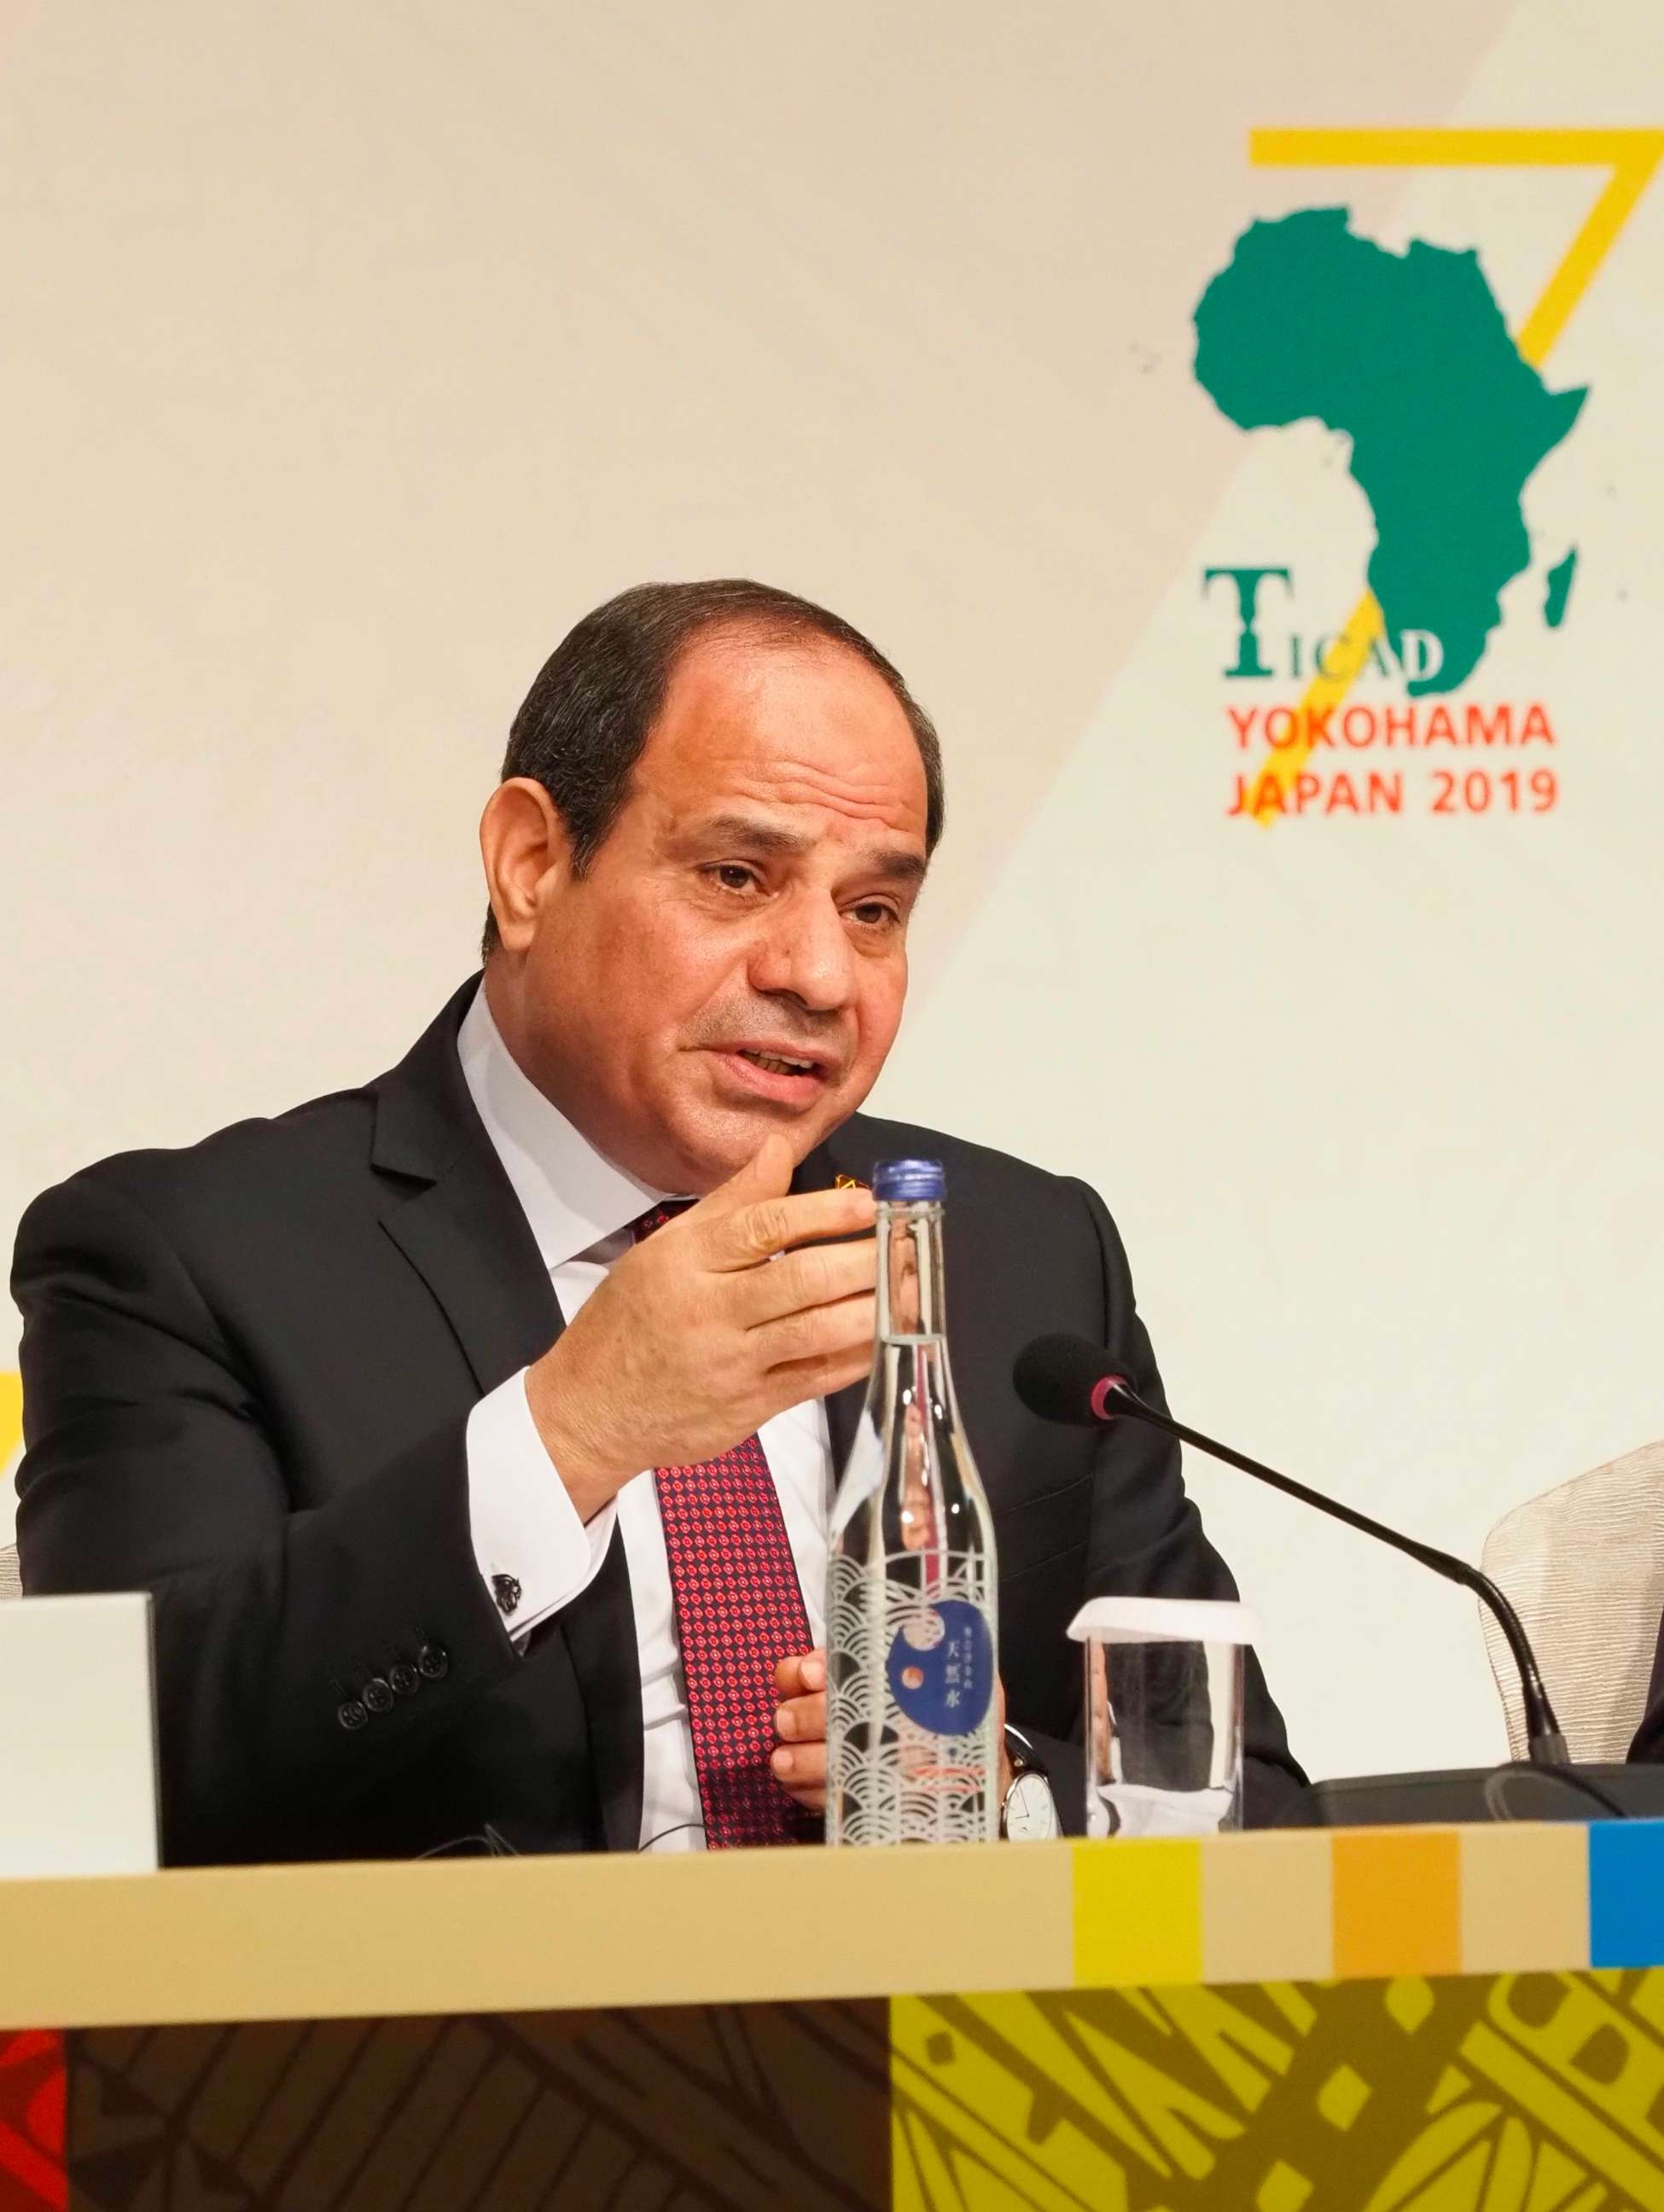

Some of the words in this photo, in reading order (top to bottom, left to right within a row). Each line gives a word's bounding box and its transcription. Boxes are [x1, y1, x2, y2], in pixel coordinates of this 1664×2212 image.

[1202, 566, 1445, 681] TICAD
[1227, 703, 1556, 751] YOKOHAMA
[1226, 770, 1403, 817] JAPAN
[1430, 769, 1557, 813] 2019
